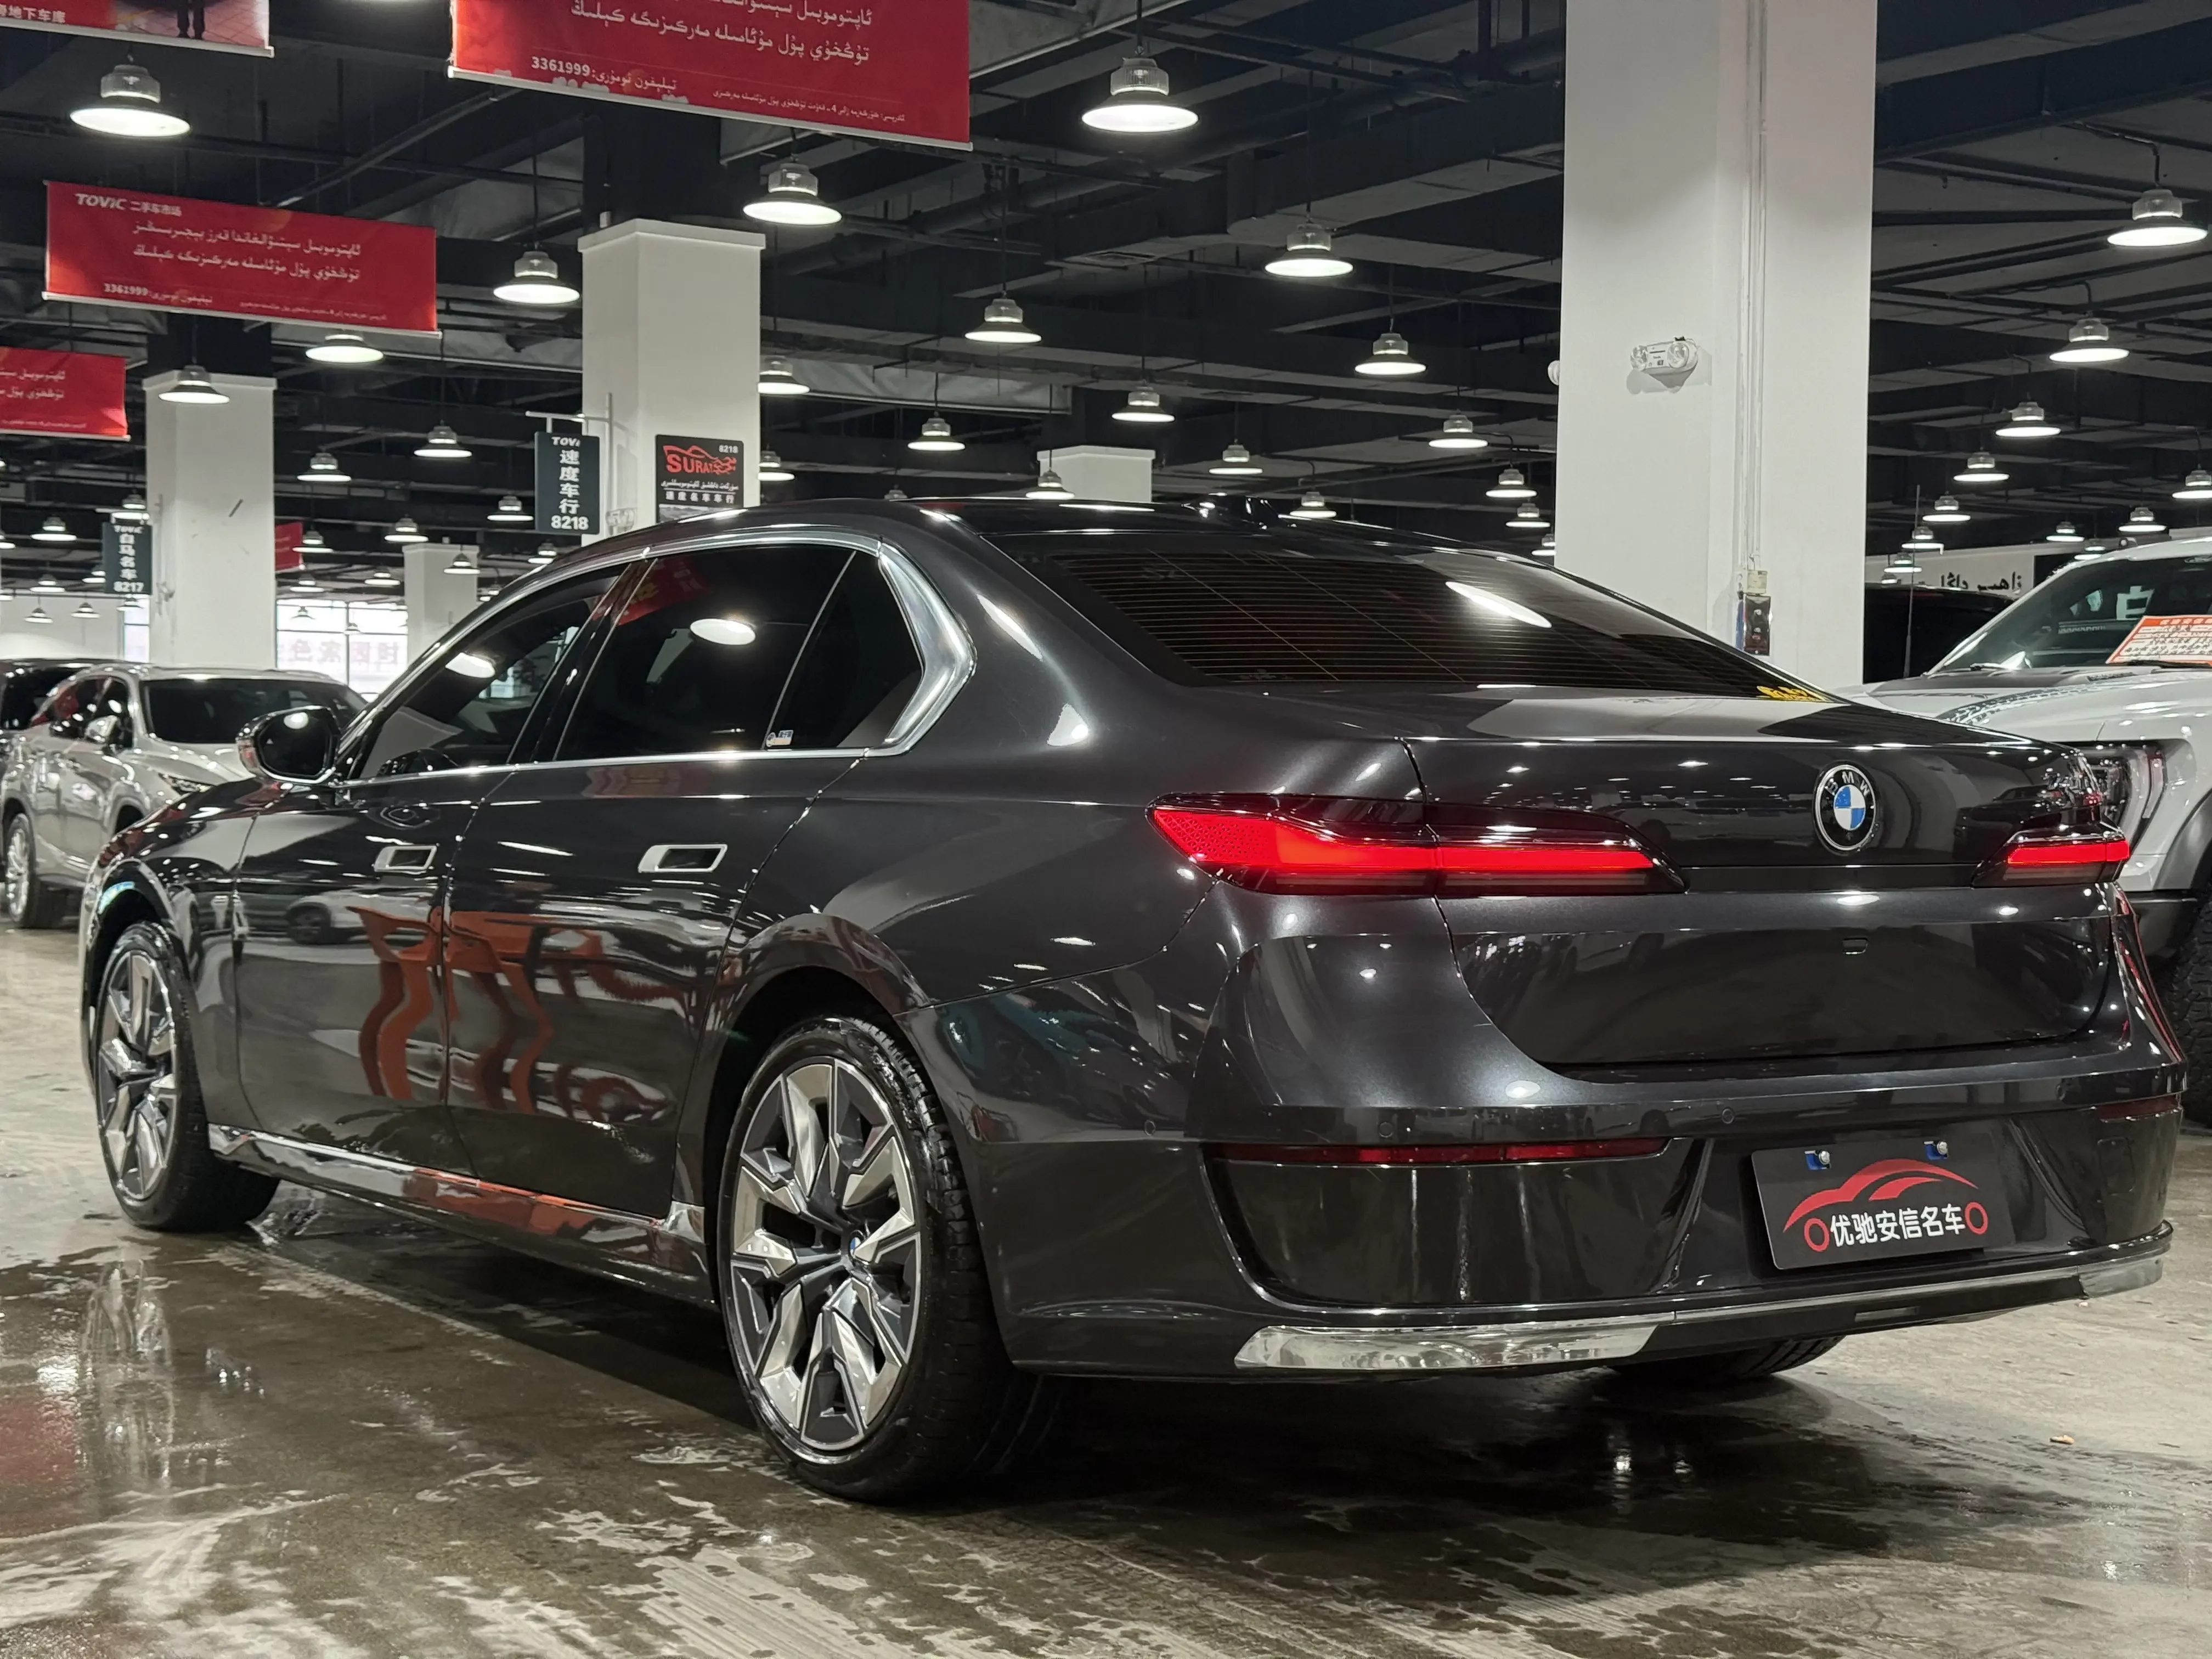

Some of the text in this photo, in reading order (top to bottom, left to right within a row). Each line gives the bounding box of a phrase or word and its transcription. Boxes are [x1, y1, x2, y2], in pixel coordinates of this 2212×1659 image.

[531, 56, 590, 77] 3361999
[75, 193, 127, 210] TOVIC
[719, 444, 739, 454] 8218
[558, 449, 580, 515] 速度车行
[551, 515, 589, 531] 8218
[113, 581, 144, 592] 8217
[1824, 771, 1870, 796] BMW
[1830, 1203, 1966, 1247] 优驰安信名车
